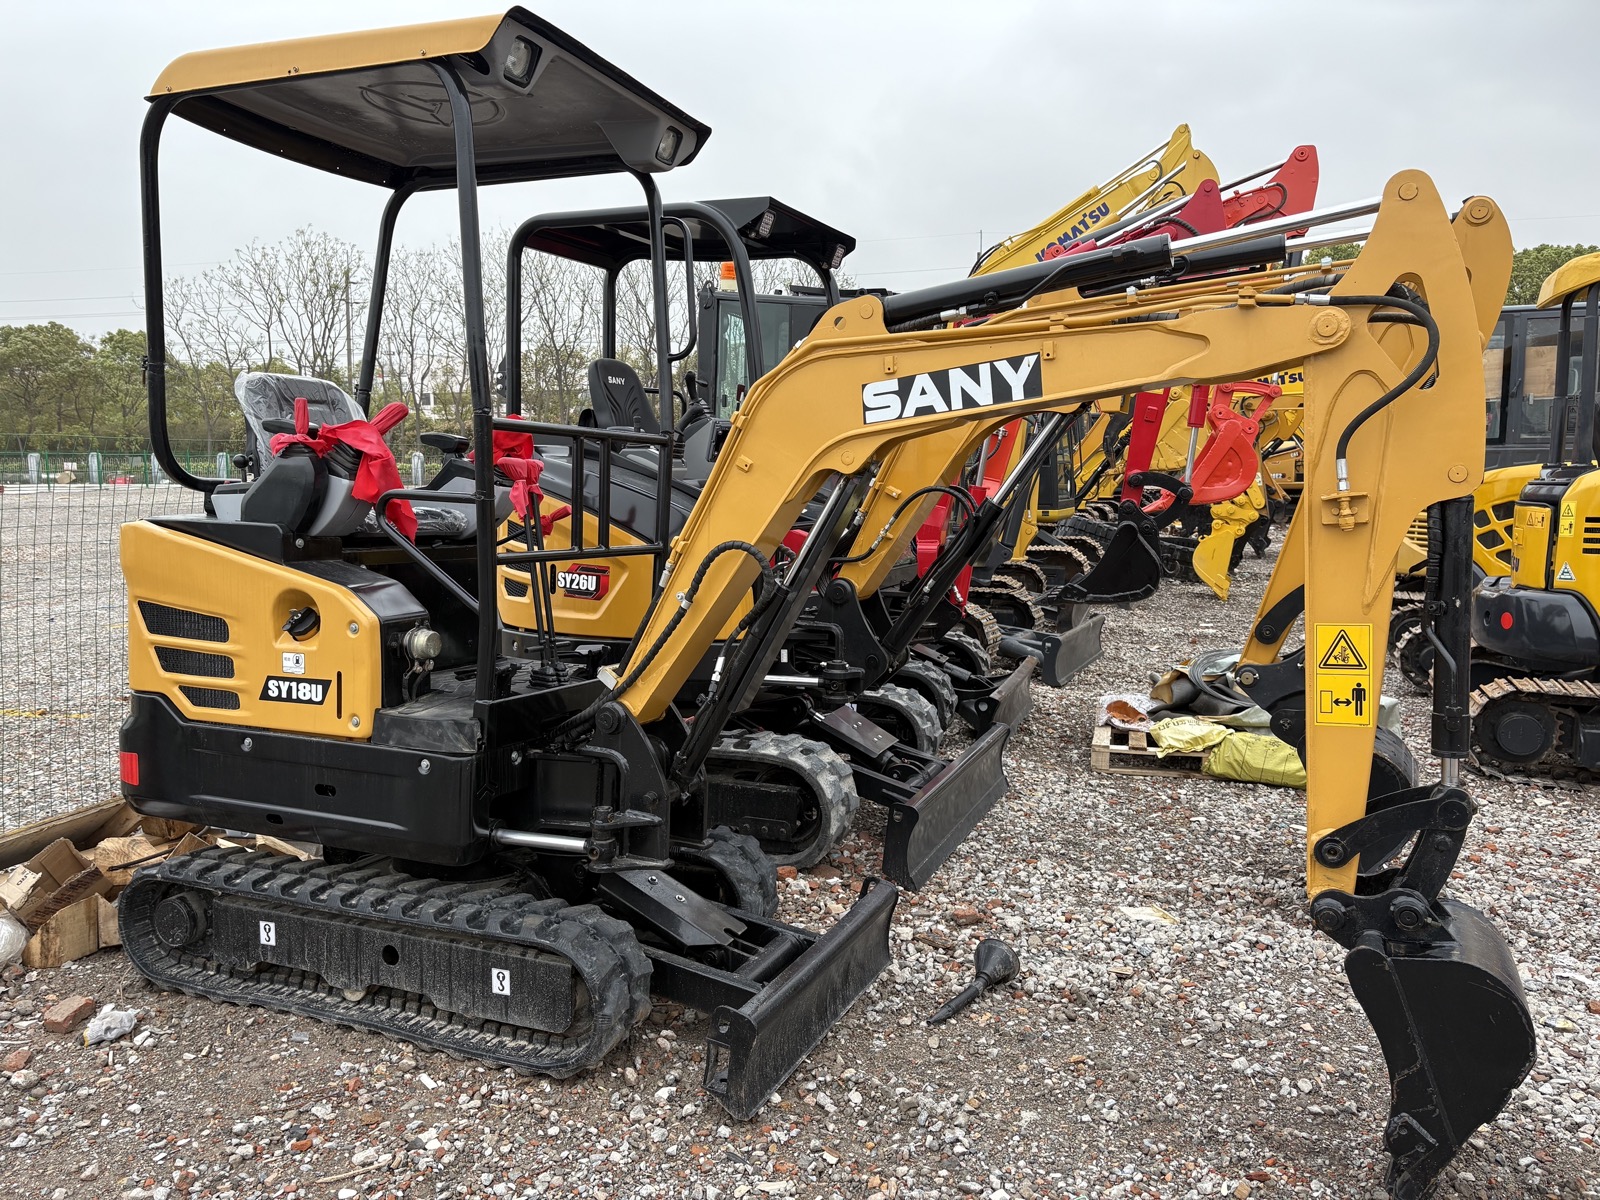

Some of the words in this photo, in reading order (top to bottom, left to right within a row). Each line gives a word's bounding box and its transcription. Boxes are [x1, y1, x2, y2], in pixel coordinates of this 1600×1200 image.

[607, 375, 626, 386] SANY
[862, 354, 1039, 424] SANY
[557, 572, 597, 591] SY26U
[267, 679, 323, 702] SY18U
